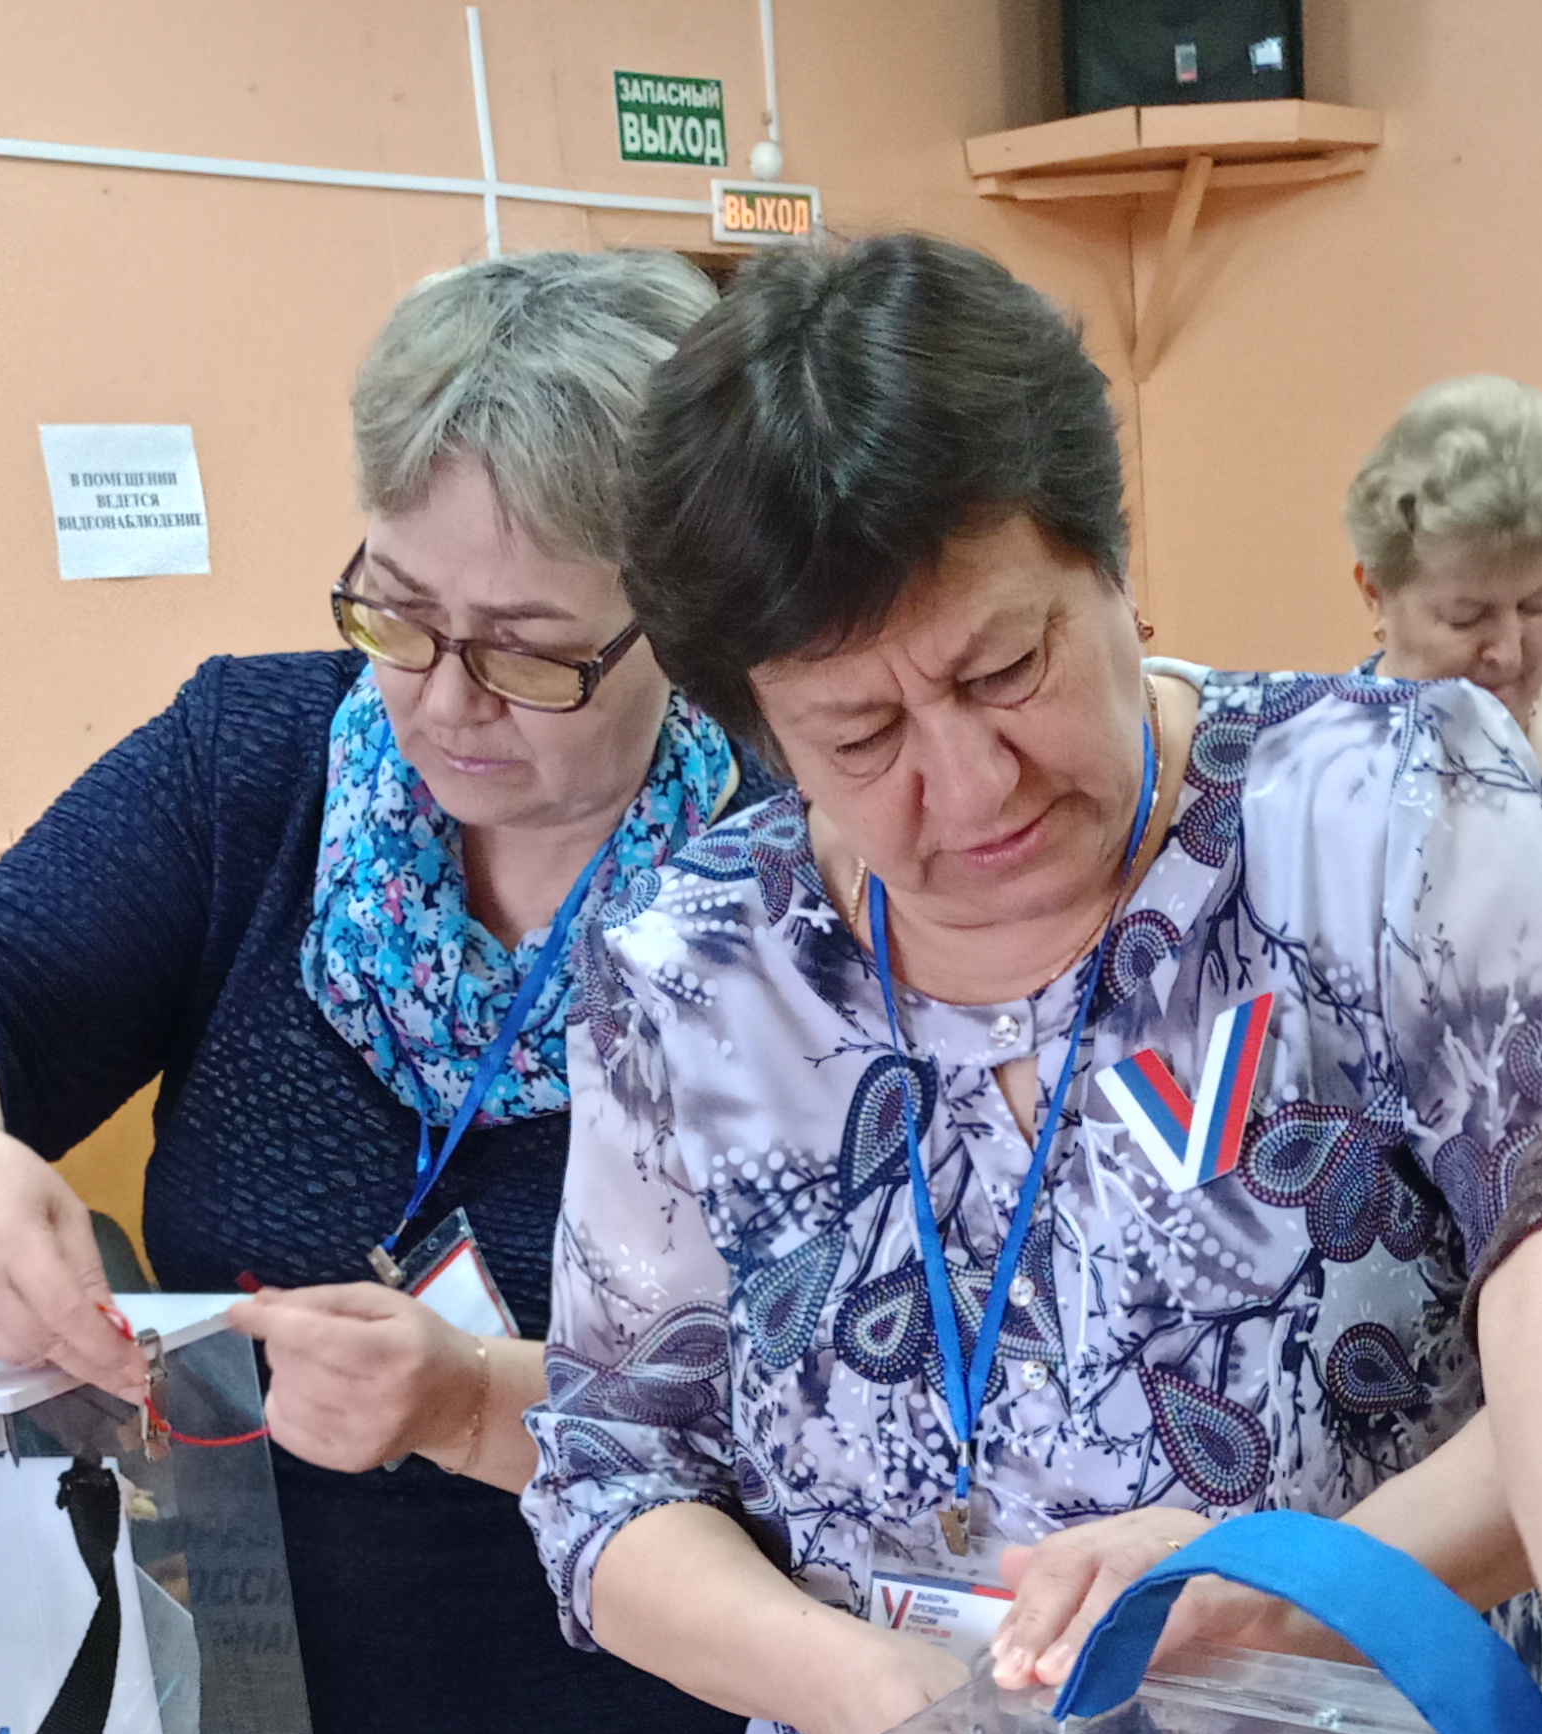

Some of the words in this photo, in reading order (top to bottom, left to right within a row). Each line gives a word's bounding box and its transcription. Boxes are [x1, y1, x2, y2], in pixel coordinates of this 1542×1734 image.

[619, 78, 720, 109] ЗАПАСНЫЙ
[622, 112, 725, 166] ВЫХОД
[724, 195, 809, 235] ВЫХОД
[70, 472, 80, 487] В
[83, 472, 178, 488] ПОМЕЩЕНИИ
[96, 493, 160, 509] ВЕДЕТСЯ
[58, 513, 203, 531] ВИДЕОНАБЛЮДЕНИЕ
